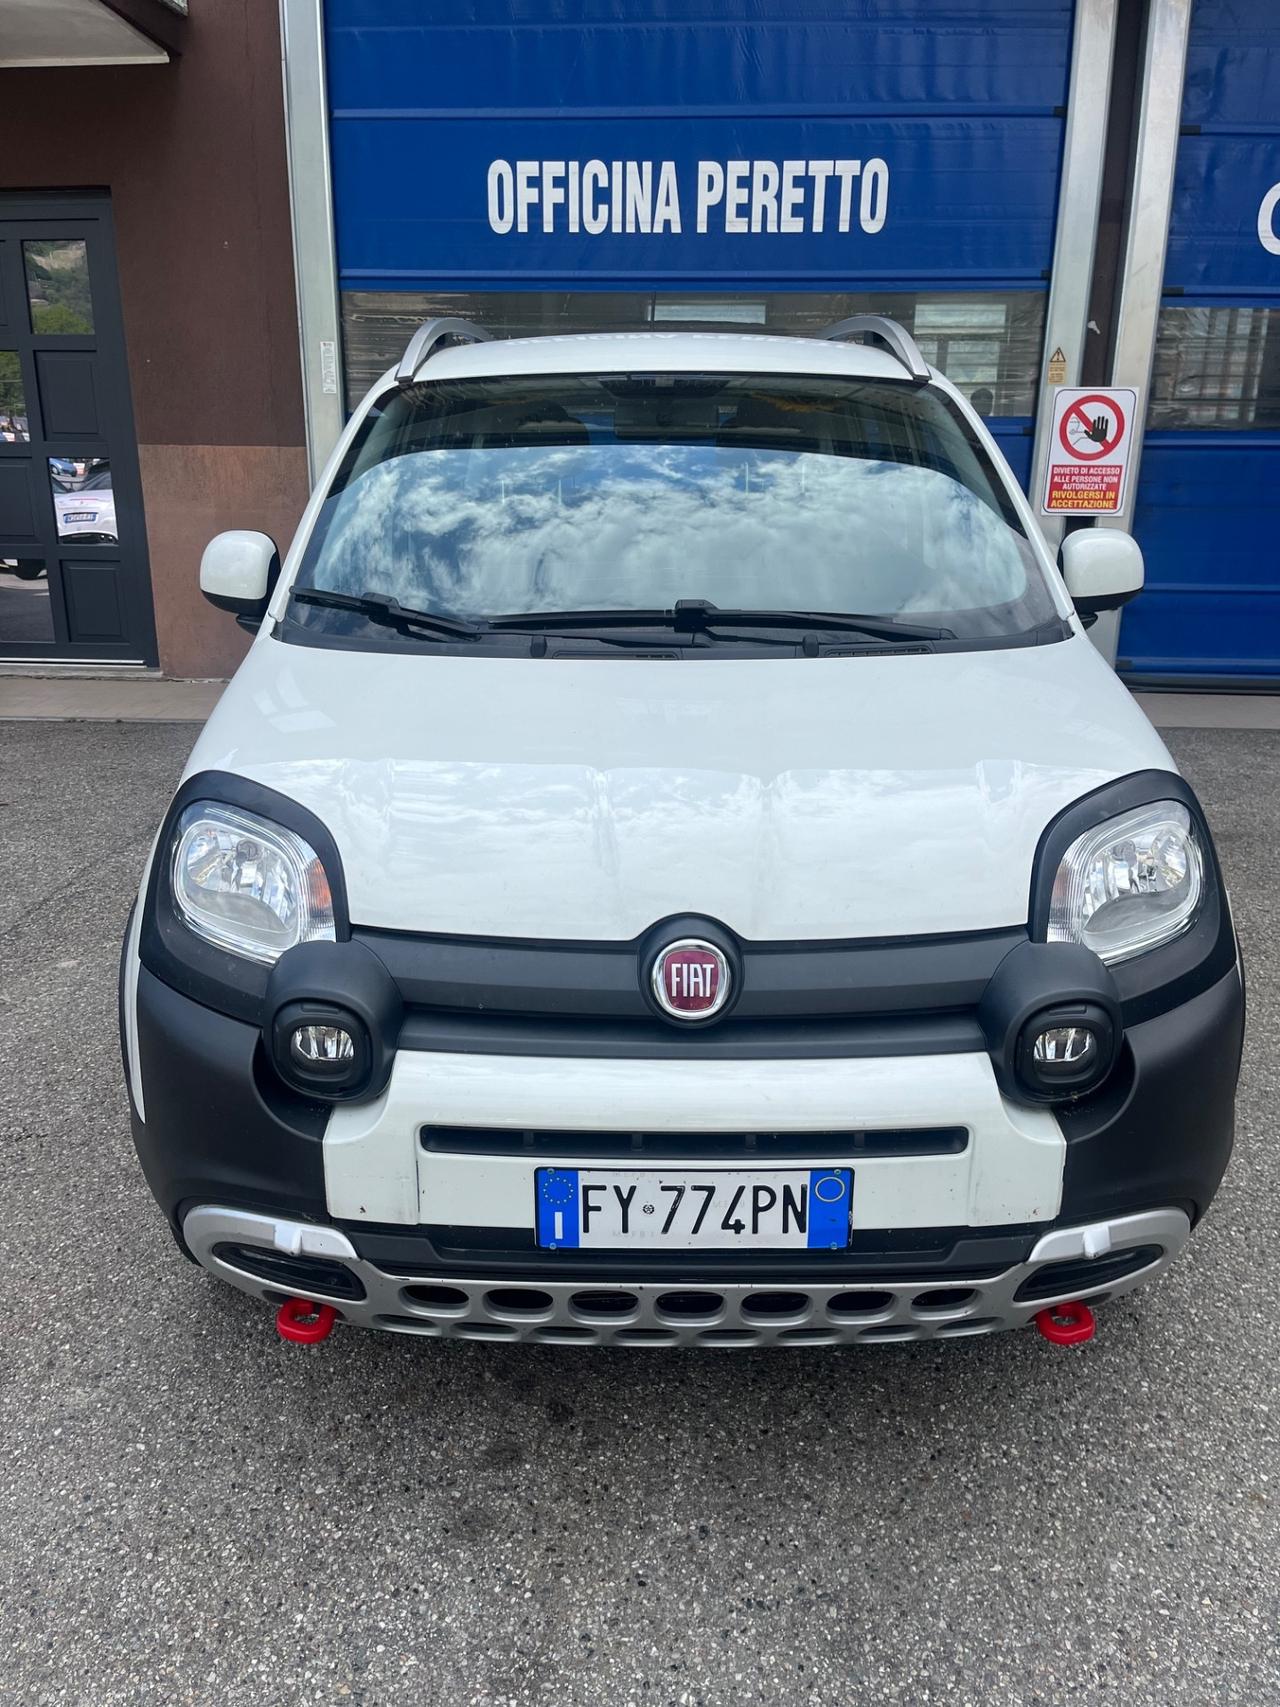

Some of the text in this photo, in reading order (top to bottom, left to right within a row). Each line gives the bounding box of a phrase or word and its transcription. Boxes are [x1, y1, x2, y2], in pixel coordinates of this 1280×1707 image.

[487, 158, 889, 235] OFFICINA PERETTO
[1053, 466, 1120, 475] DIVIETO DI ACCESSO
[1053, 475, 1070, 483] ALLE
[1071, 475, 1101, 483] PERSONE
[1062, 482, 1107, 490] AUTORIZZATE
[1052, 490, 1116, 499] RIVOLGERSI IN
[1050, 500, 1114, 508] ACCETTAZIONE
[671, 963, 715, 997] FIAT
